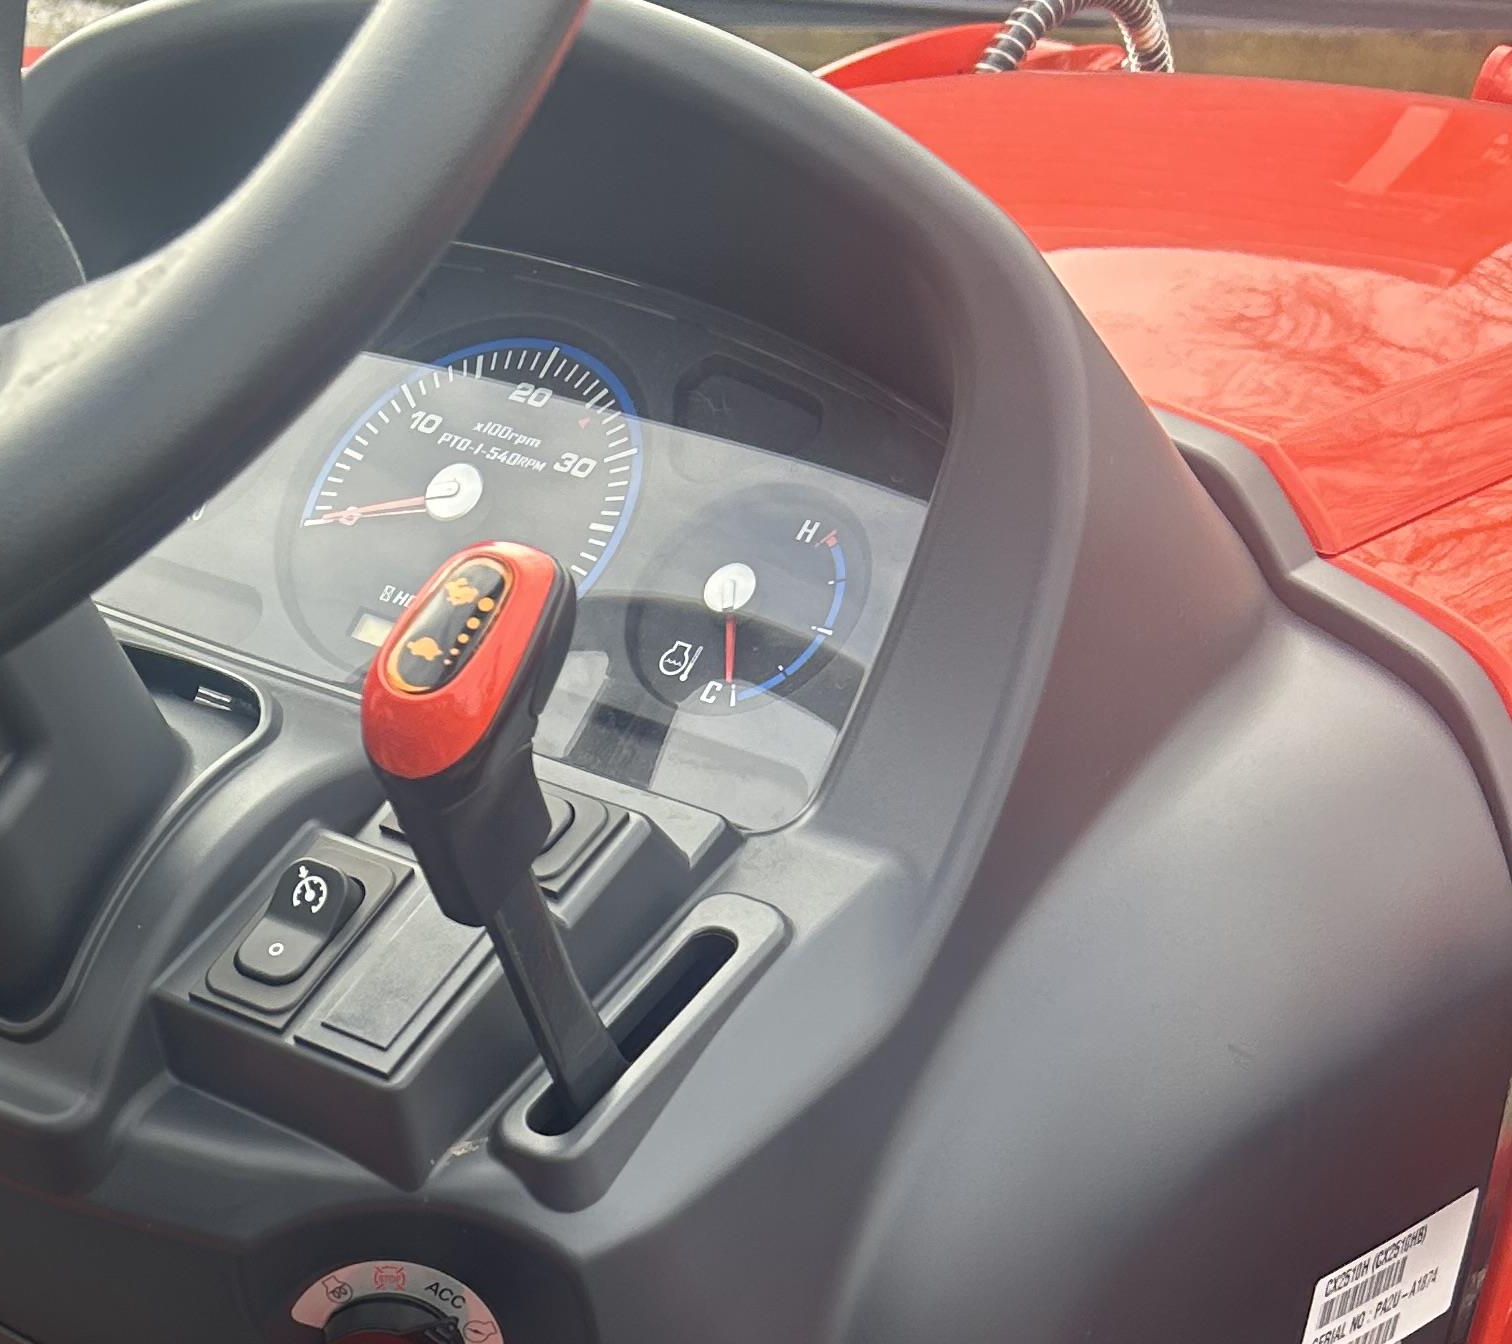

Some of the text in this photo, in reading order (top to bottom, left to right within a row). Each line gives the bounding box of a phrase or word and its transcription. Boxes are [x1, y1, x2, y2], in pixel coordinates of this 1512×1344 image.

[508, 382, 553, 408] 20
[409, 410, 443, 434] 10
[472, 421, 542, 448] x100rpm
[553, 452, 597, 478] 30
[795, 519, 821, 543] H
[699, 680, 723, 704] C
[1324, 1256, 1371, 1297] CX2510H
[423, 1281, 466, 1310] ACC
